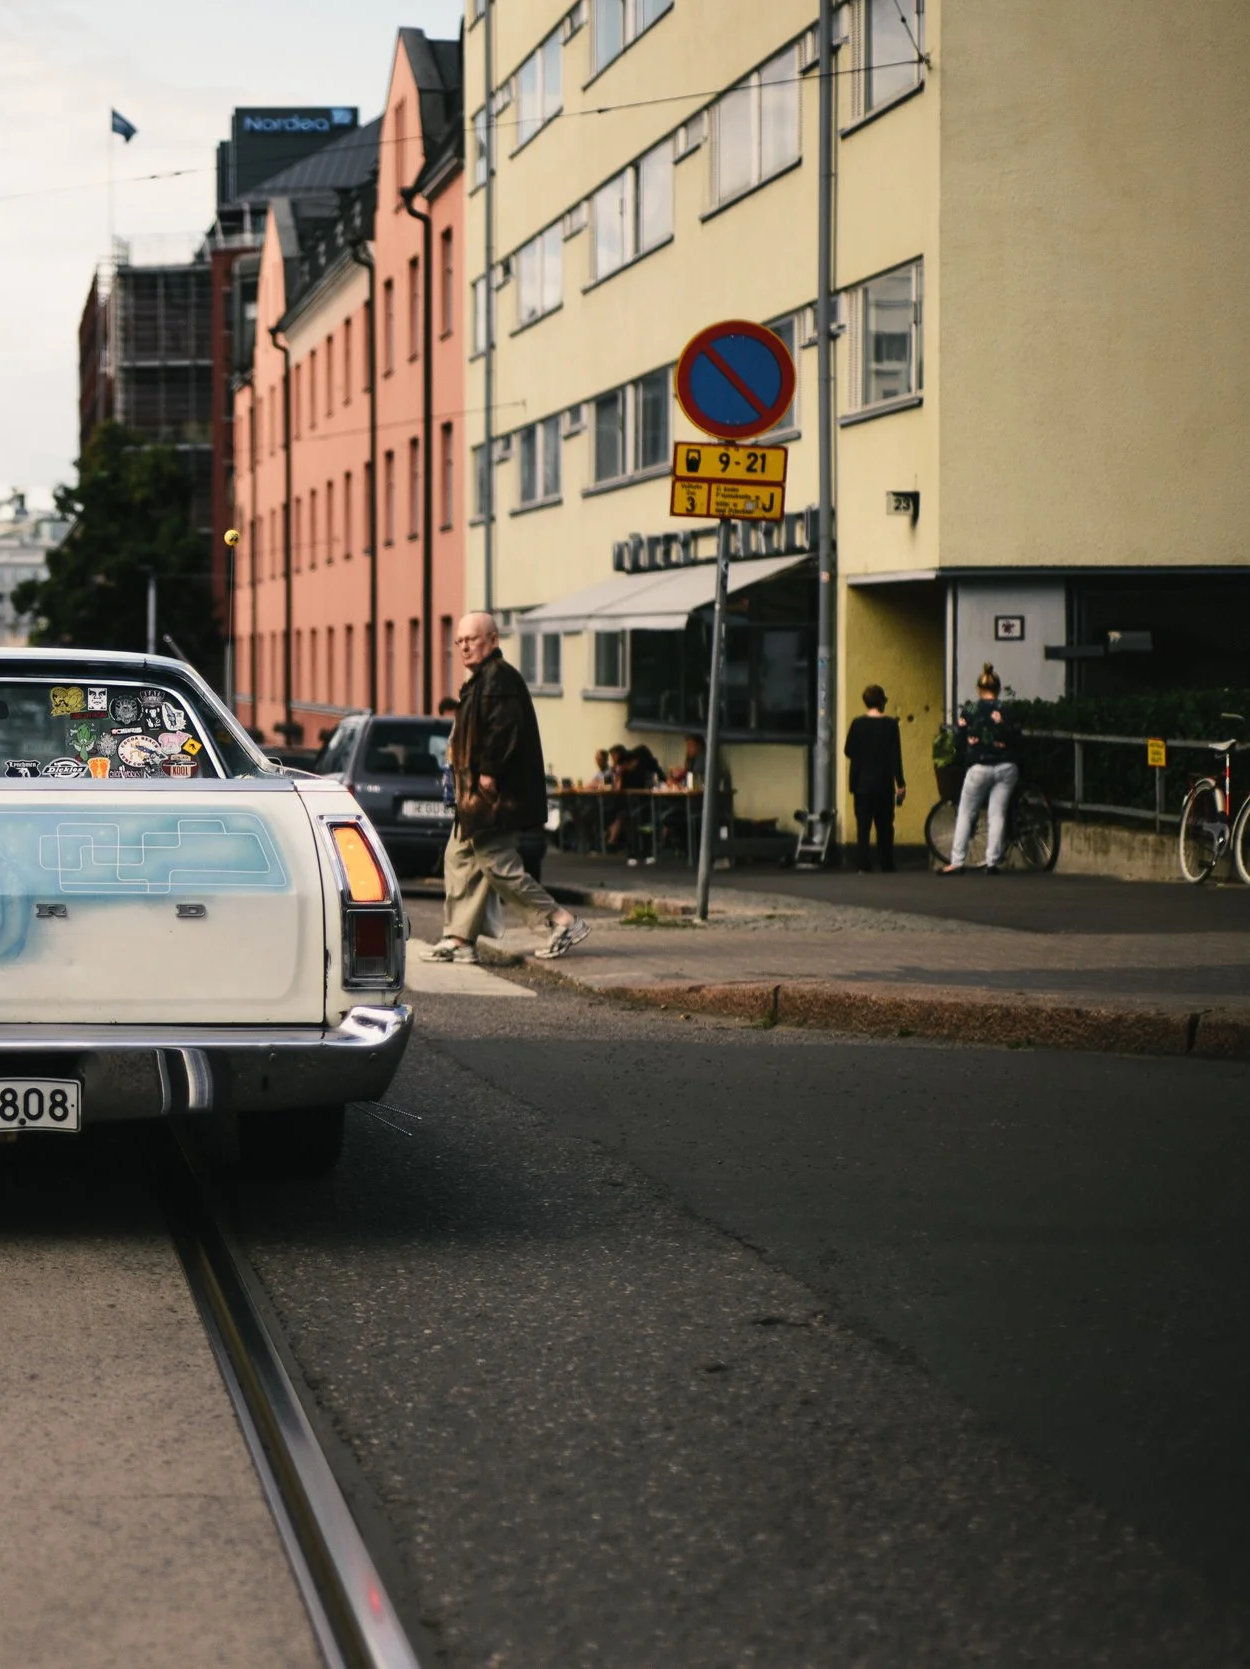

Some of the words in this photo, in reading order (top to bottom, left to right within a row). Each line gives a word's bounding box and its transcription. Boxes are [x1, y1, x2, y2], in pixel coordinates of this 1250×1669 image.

[243, 114, 330, 132] Nordea
[685, 496, 696, 513] 3
[761, 492, 775, 513] J
[894, 496, 911, 512] 23
[120, 736, 139, 749] COCOA
[140, 736, 159, 749] BEACH
[47, 766, 84, 774] Dickies
[172, 765, 188, 776] KOOL
